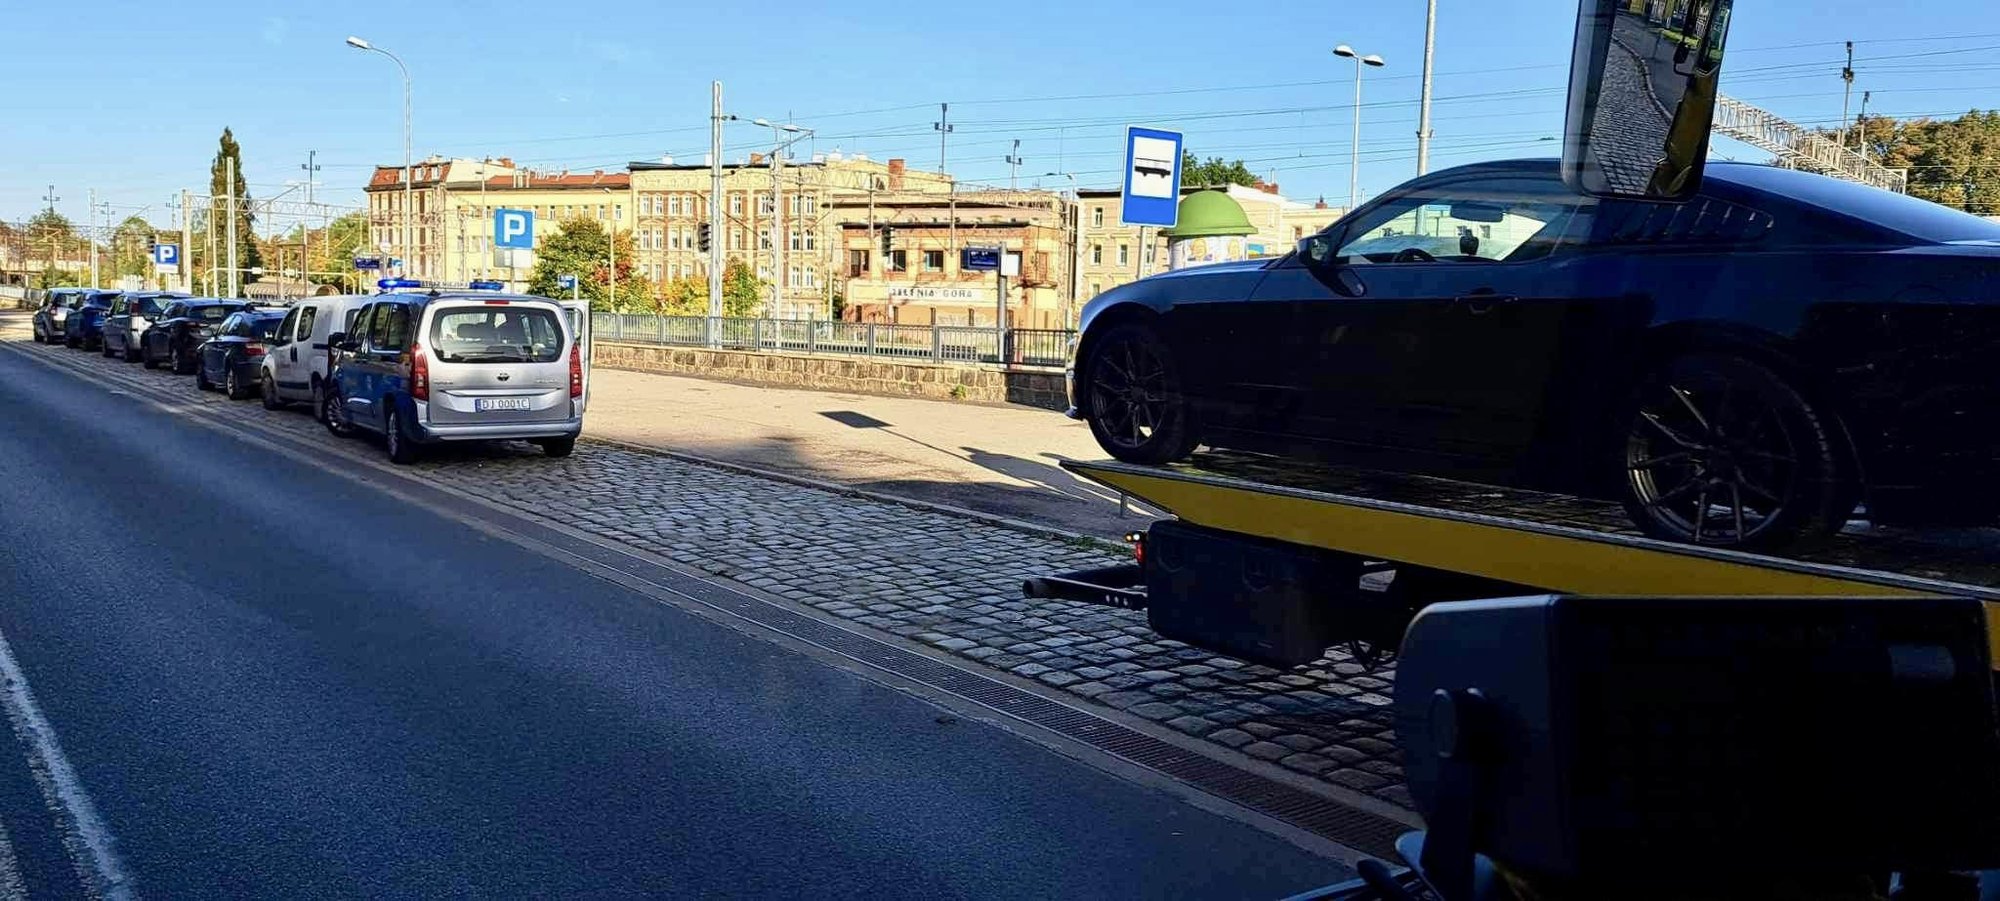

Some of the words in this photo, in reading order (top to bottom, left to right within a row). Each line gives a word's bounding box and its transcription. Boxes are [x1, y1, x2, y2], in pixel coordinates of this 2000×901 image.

[503, 213, 525, 243] P
[160, 245, 174, 262] P
[482, 400, 494, 409] DJ
